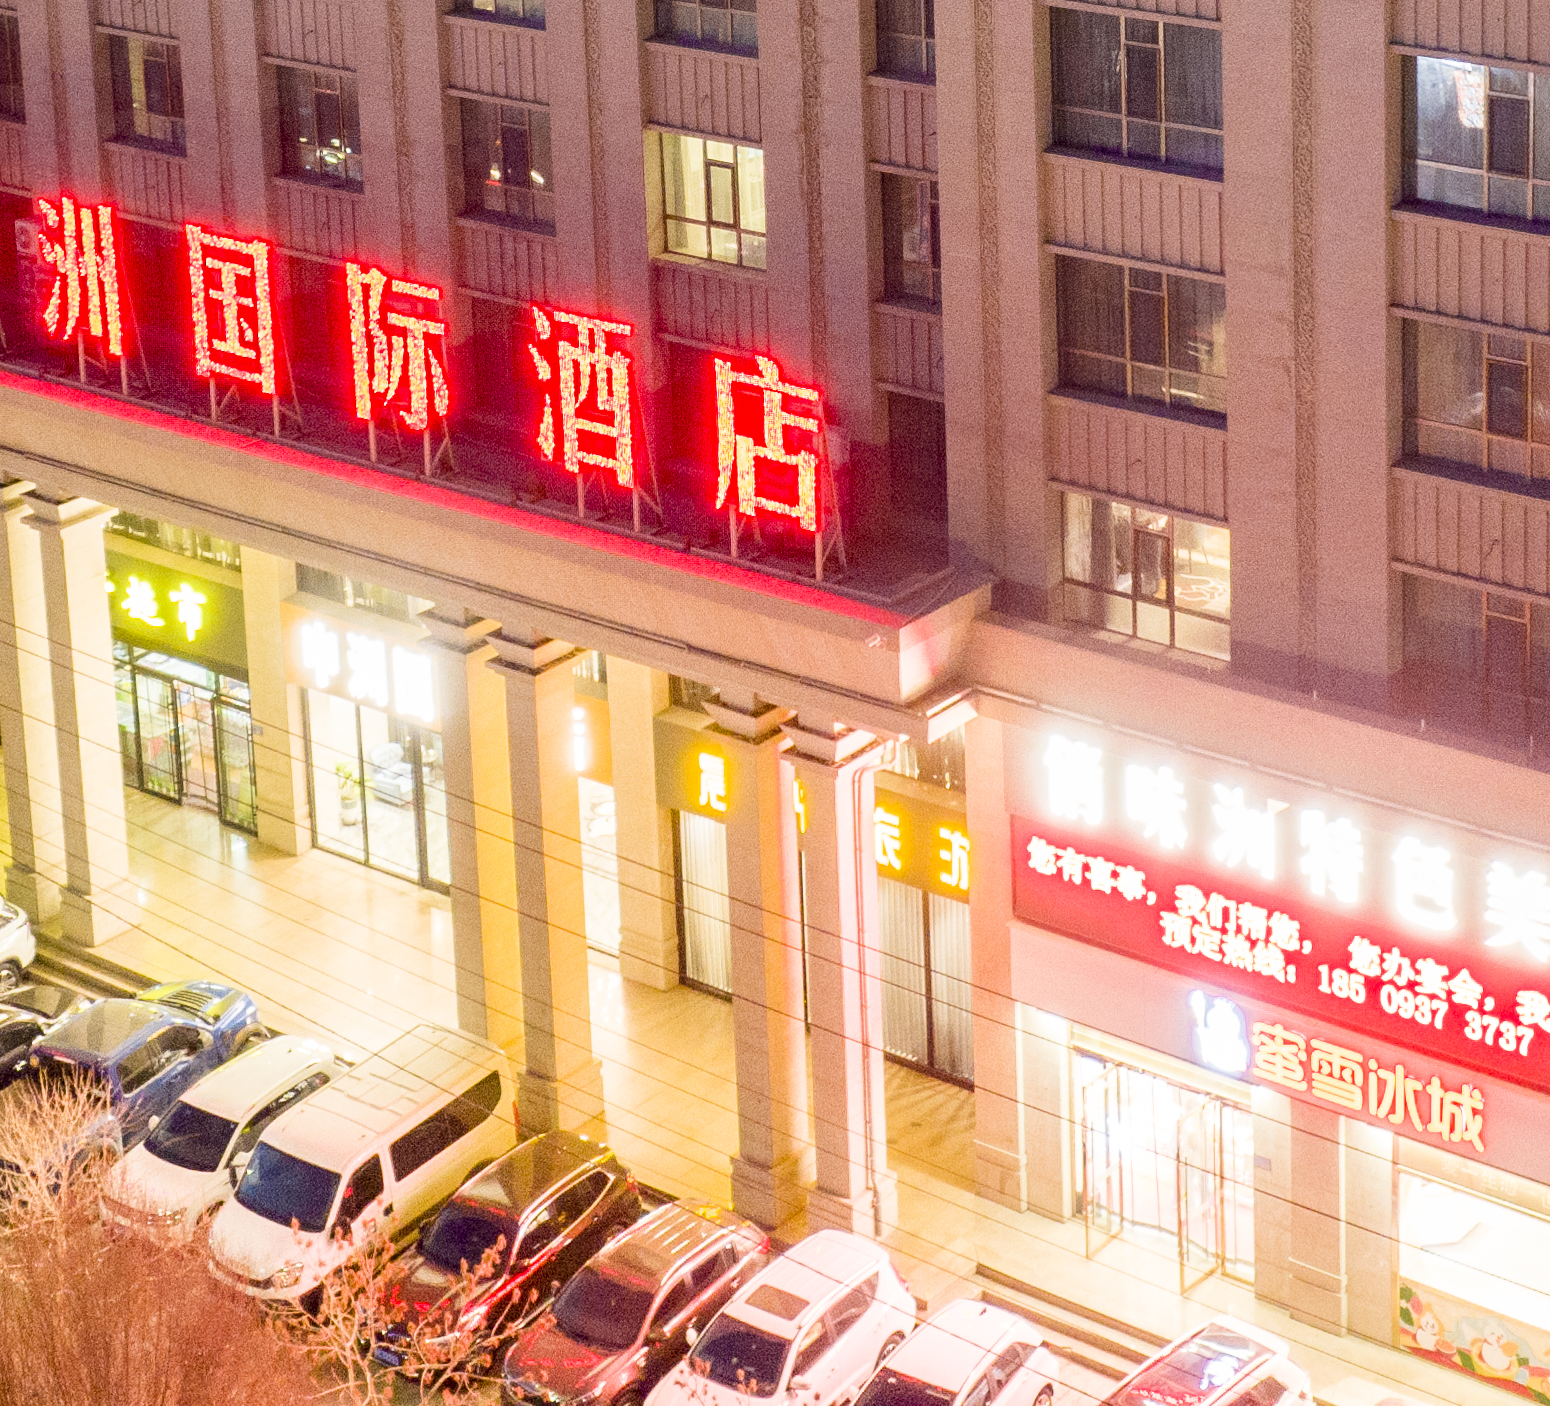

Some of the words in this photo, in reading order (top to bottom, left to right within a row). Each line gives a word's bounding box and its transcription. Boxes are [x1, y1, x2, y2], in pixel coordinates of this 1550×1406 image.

[121, 576, 207, 642] 超市
[1318, 964, 1367, 1005] 185
[1381, 977, 1449, 1031] 0937
[1464, 1009, 1534, 1057] 3737
[1250, 1021, 1485, 1153] 蜜雪冰城
